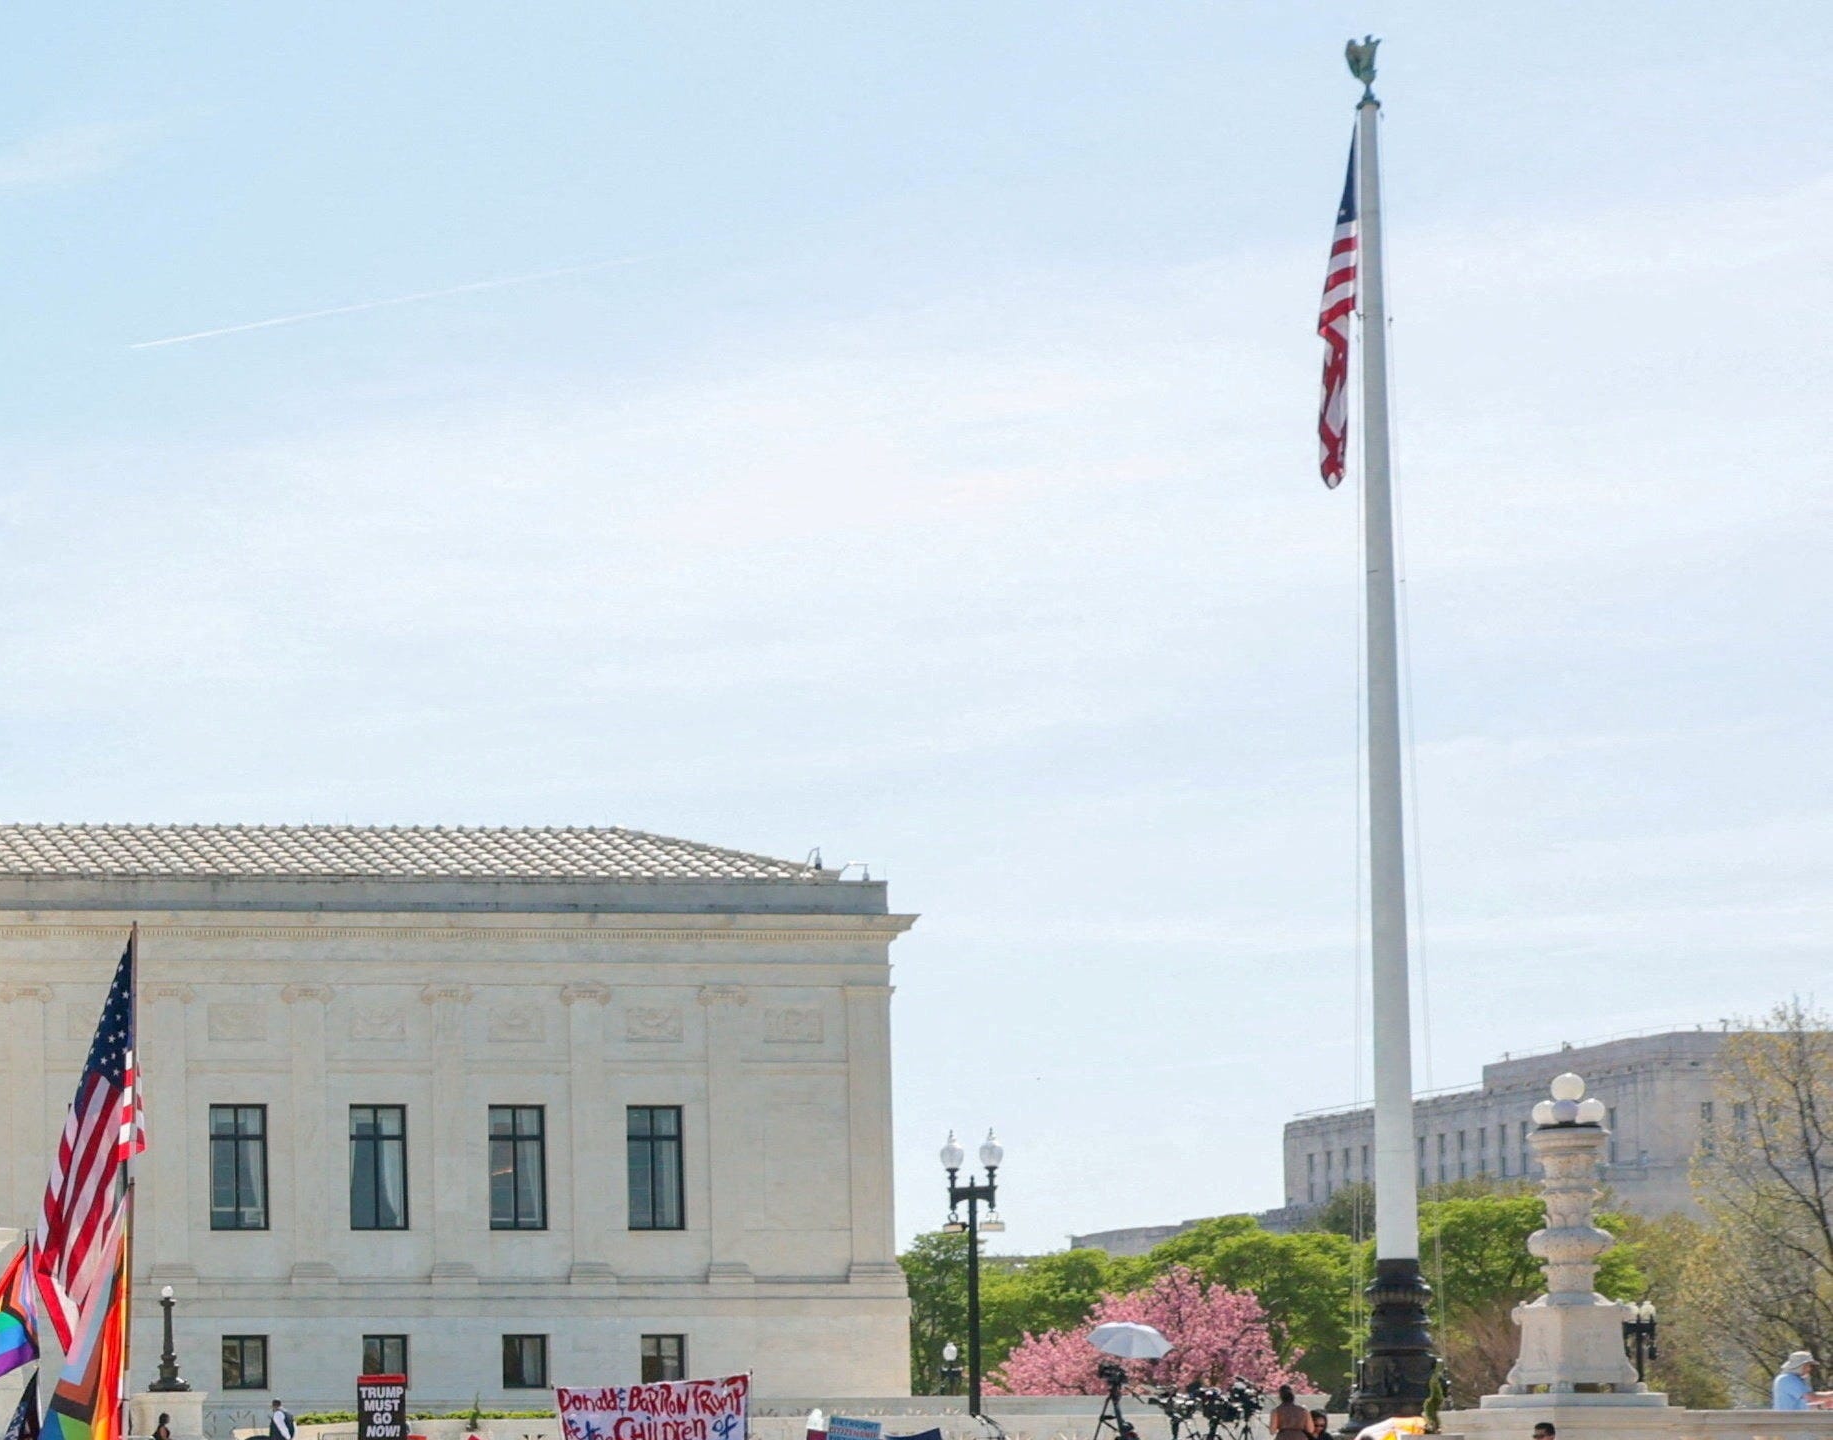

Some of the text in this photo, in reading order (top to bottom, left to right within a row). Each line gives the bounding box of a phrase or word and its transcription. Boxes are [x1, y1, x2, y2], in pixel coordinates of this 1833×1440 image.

[359, 1387, 404, 1399] TRUMP
[364, 1400, 401, 1411] MUST
[373, 1412, 392, 1424] GO
[366, 1425, 401, 1437] NOW!
